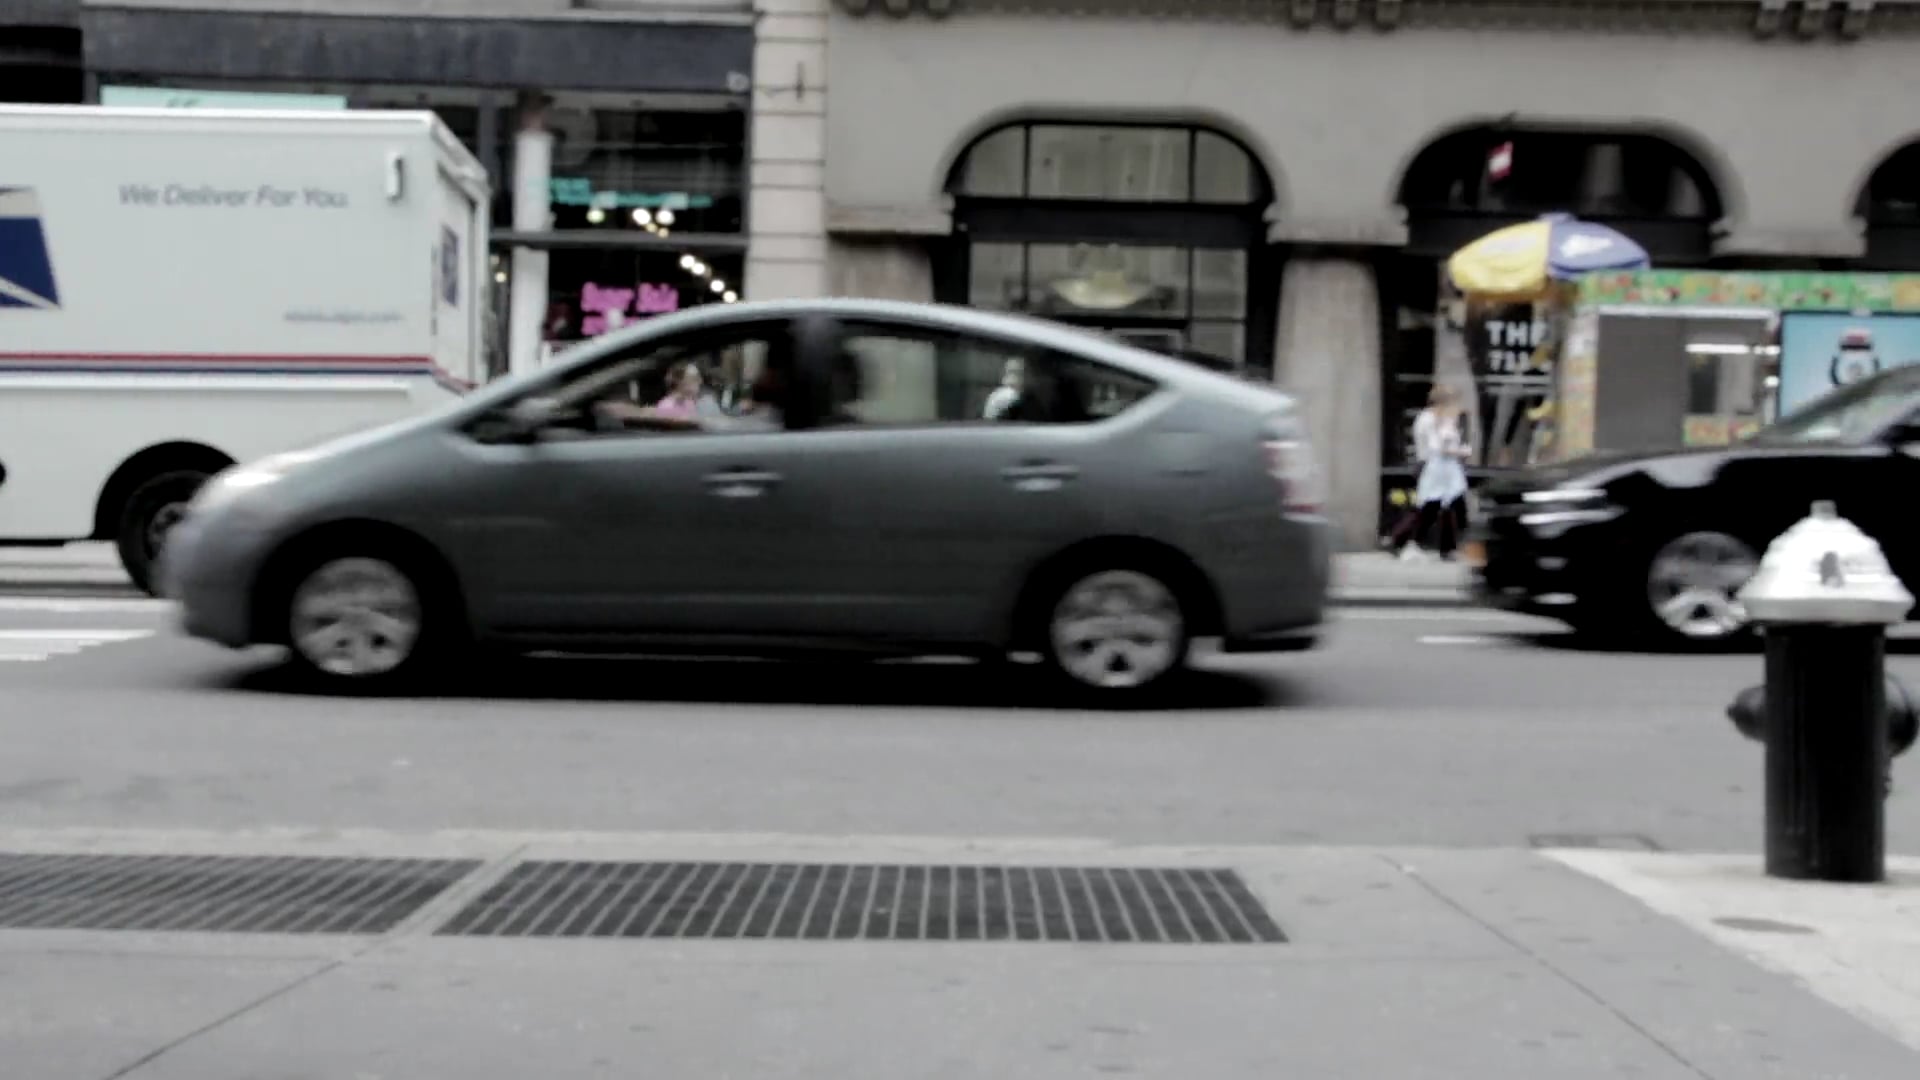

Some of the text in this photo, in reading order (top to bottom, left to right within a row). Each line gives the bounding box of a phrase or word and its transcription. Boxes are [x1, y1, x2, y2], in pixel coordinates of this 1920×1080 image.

[118, 184, 158, 206] We
[162, 183, 250, 207] Deliver
[256, 184, 298, 208] For
